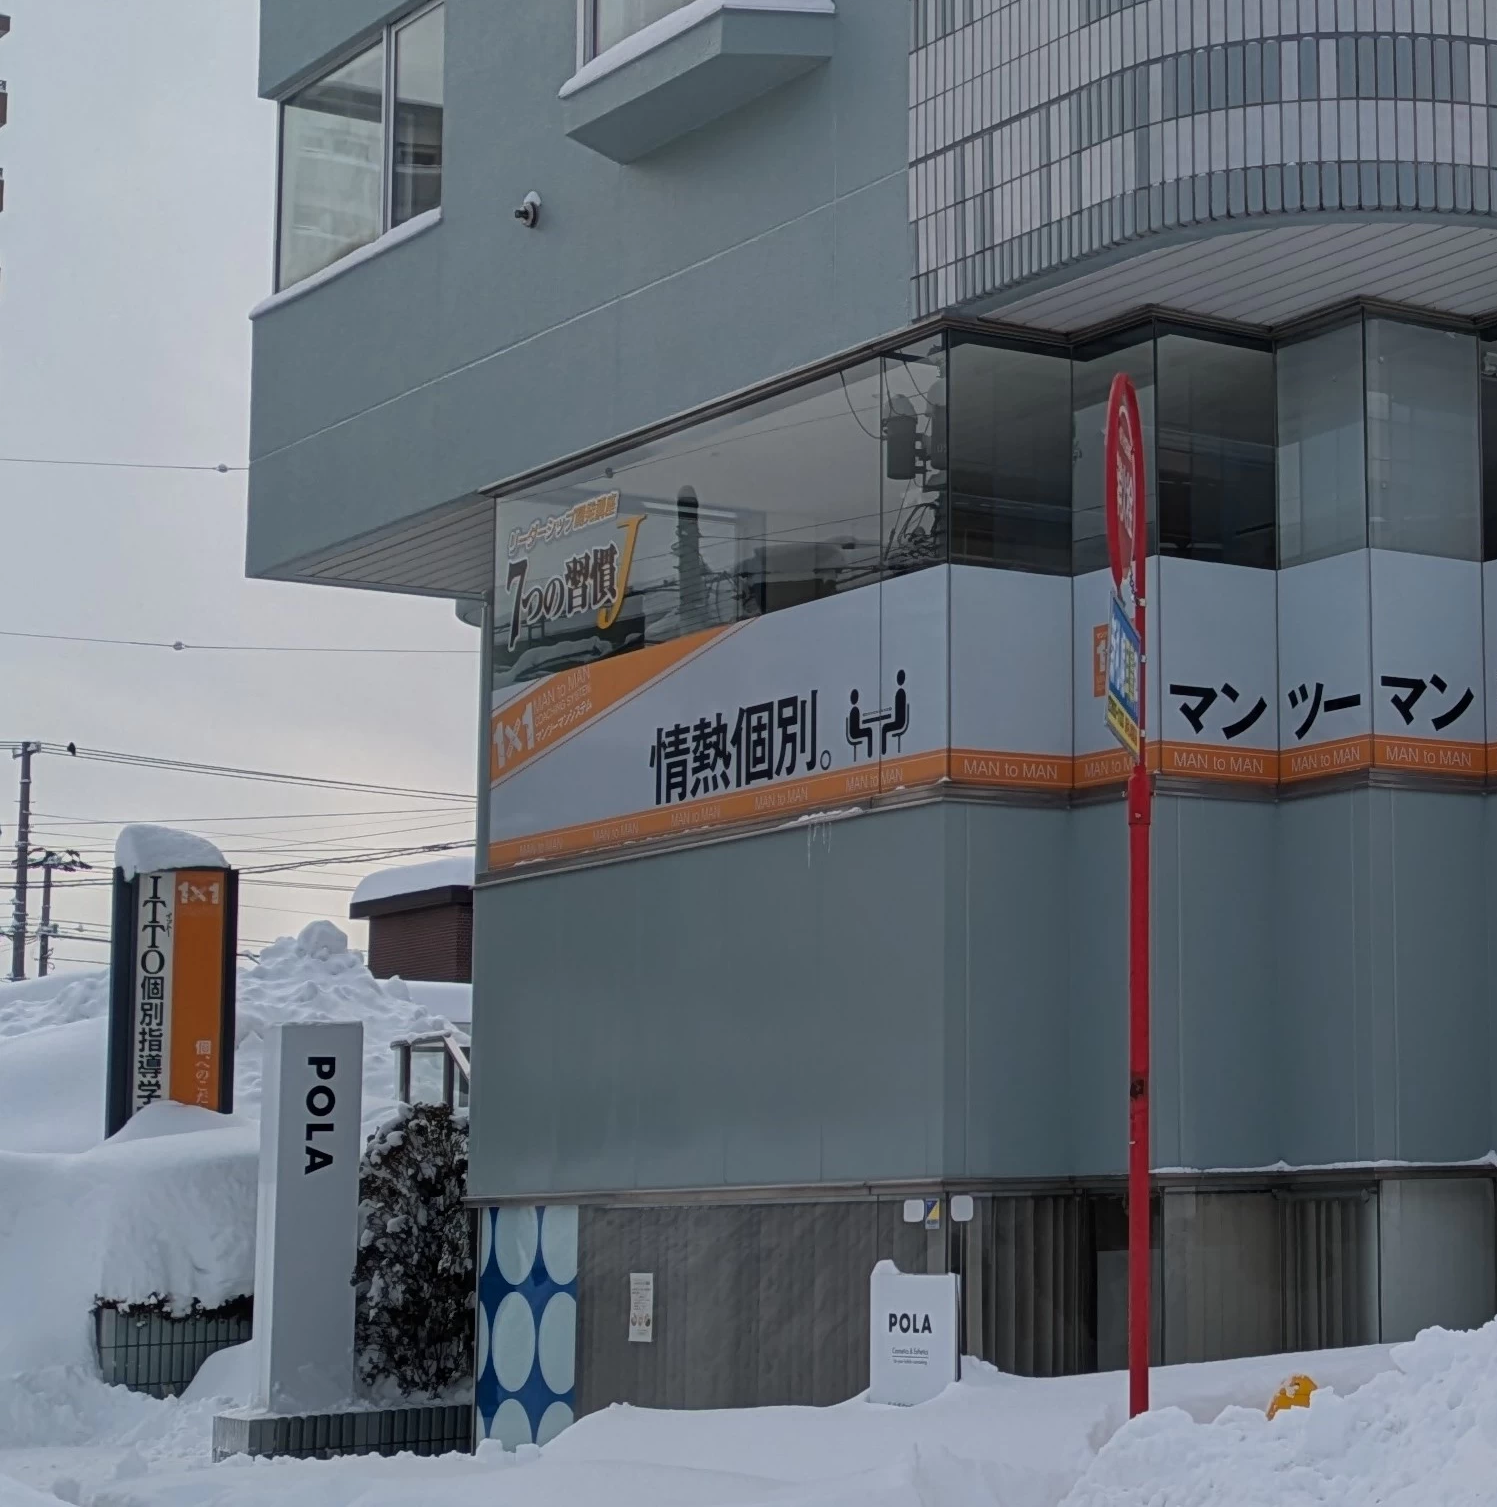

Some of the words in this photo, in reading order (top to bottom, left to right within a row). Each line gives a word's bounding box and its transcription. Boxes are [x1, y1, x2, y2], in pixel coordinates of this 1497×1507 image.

[1174, 751, 1208, 767] MAN
[1213, 752, 1226, 770] to
[1230, 756, 1263, 773] MAN
[1291, 756, 1316, 772] MAN
[1320, 754, 1331, 767] to
[1333, 746, 1360, 764] MAN
[1387, 746, 1419, 763] MAN
[1424, 747, 1436, 763] to
[1439, 750, 1472, 767] MAN
[964, 758, 1000, 775] MAN
[1005, 762, 1018, 777] to
[1022, 763, 1057, 780] MAN
[1085, 762, 1109, 777] MAN
[304, 1056, 336, 1175] POLA
[888, 1313, 933, 1334] POLA
